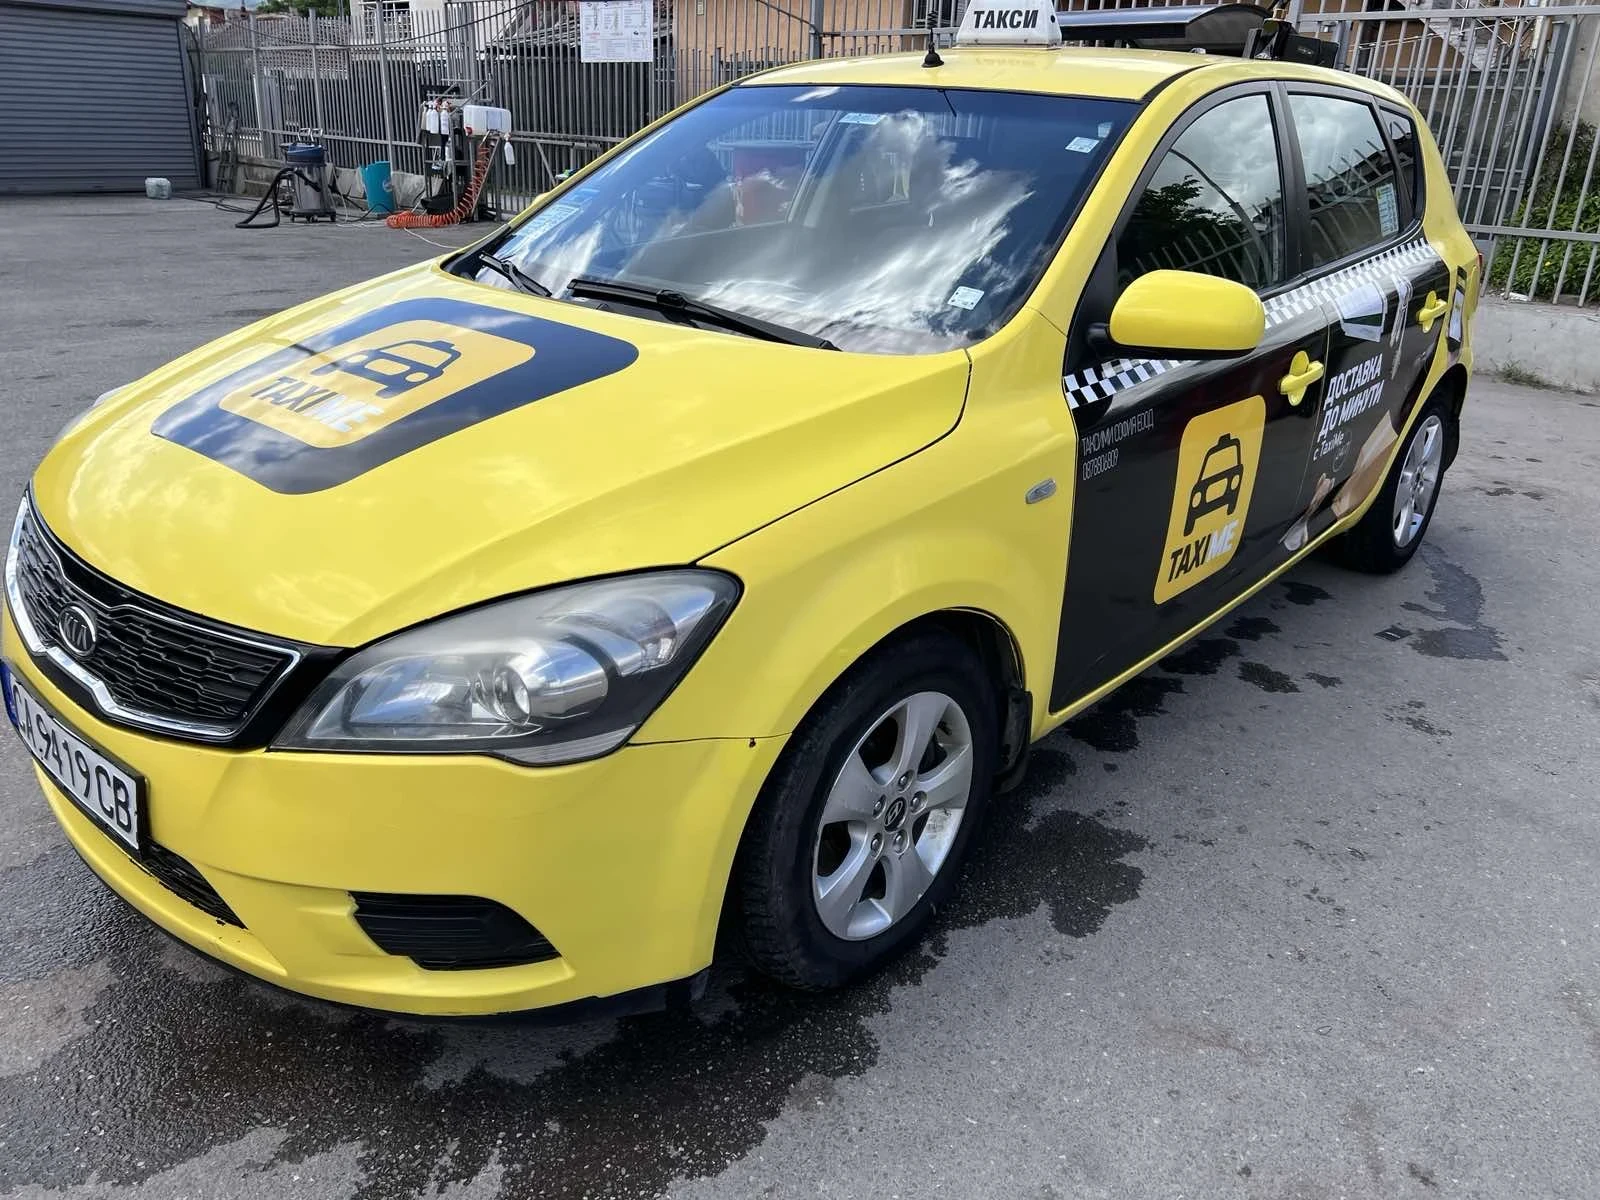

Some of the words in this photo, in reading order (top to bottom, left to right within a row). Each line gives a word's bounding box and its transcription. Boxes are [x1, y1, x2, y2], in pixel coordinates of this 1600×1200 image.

[974, 10, 1038, 29] ТАКСИ
[1324, 353, 1383, 410] ДОСТАВКА
[1317, 405, 1340, 443] ДО
[1338, 381, 1384, 426] МИНУТИ
[63, 612, 88, 650] KIA
